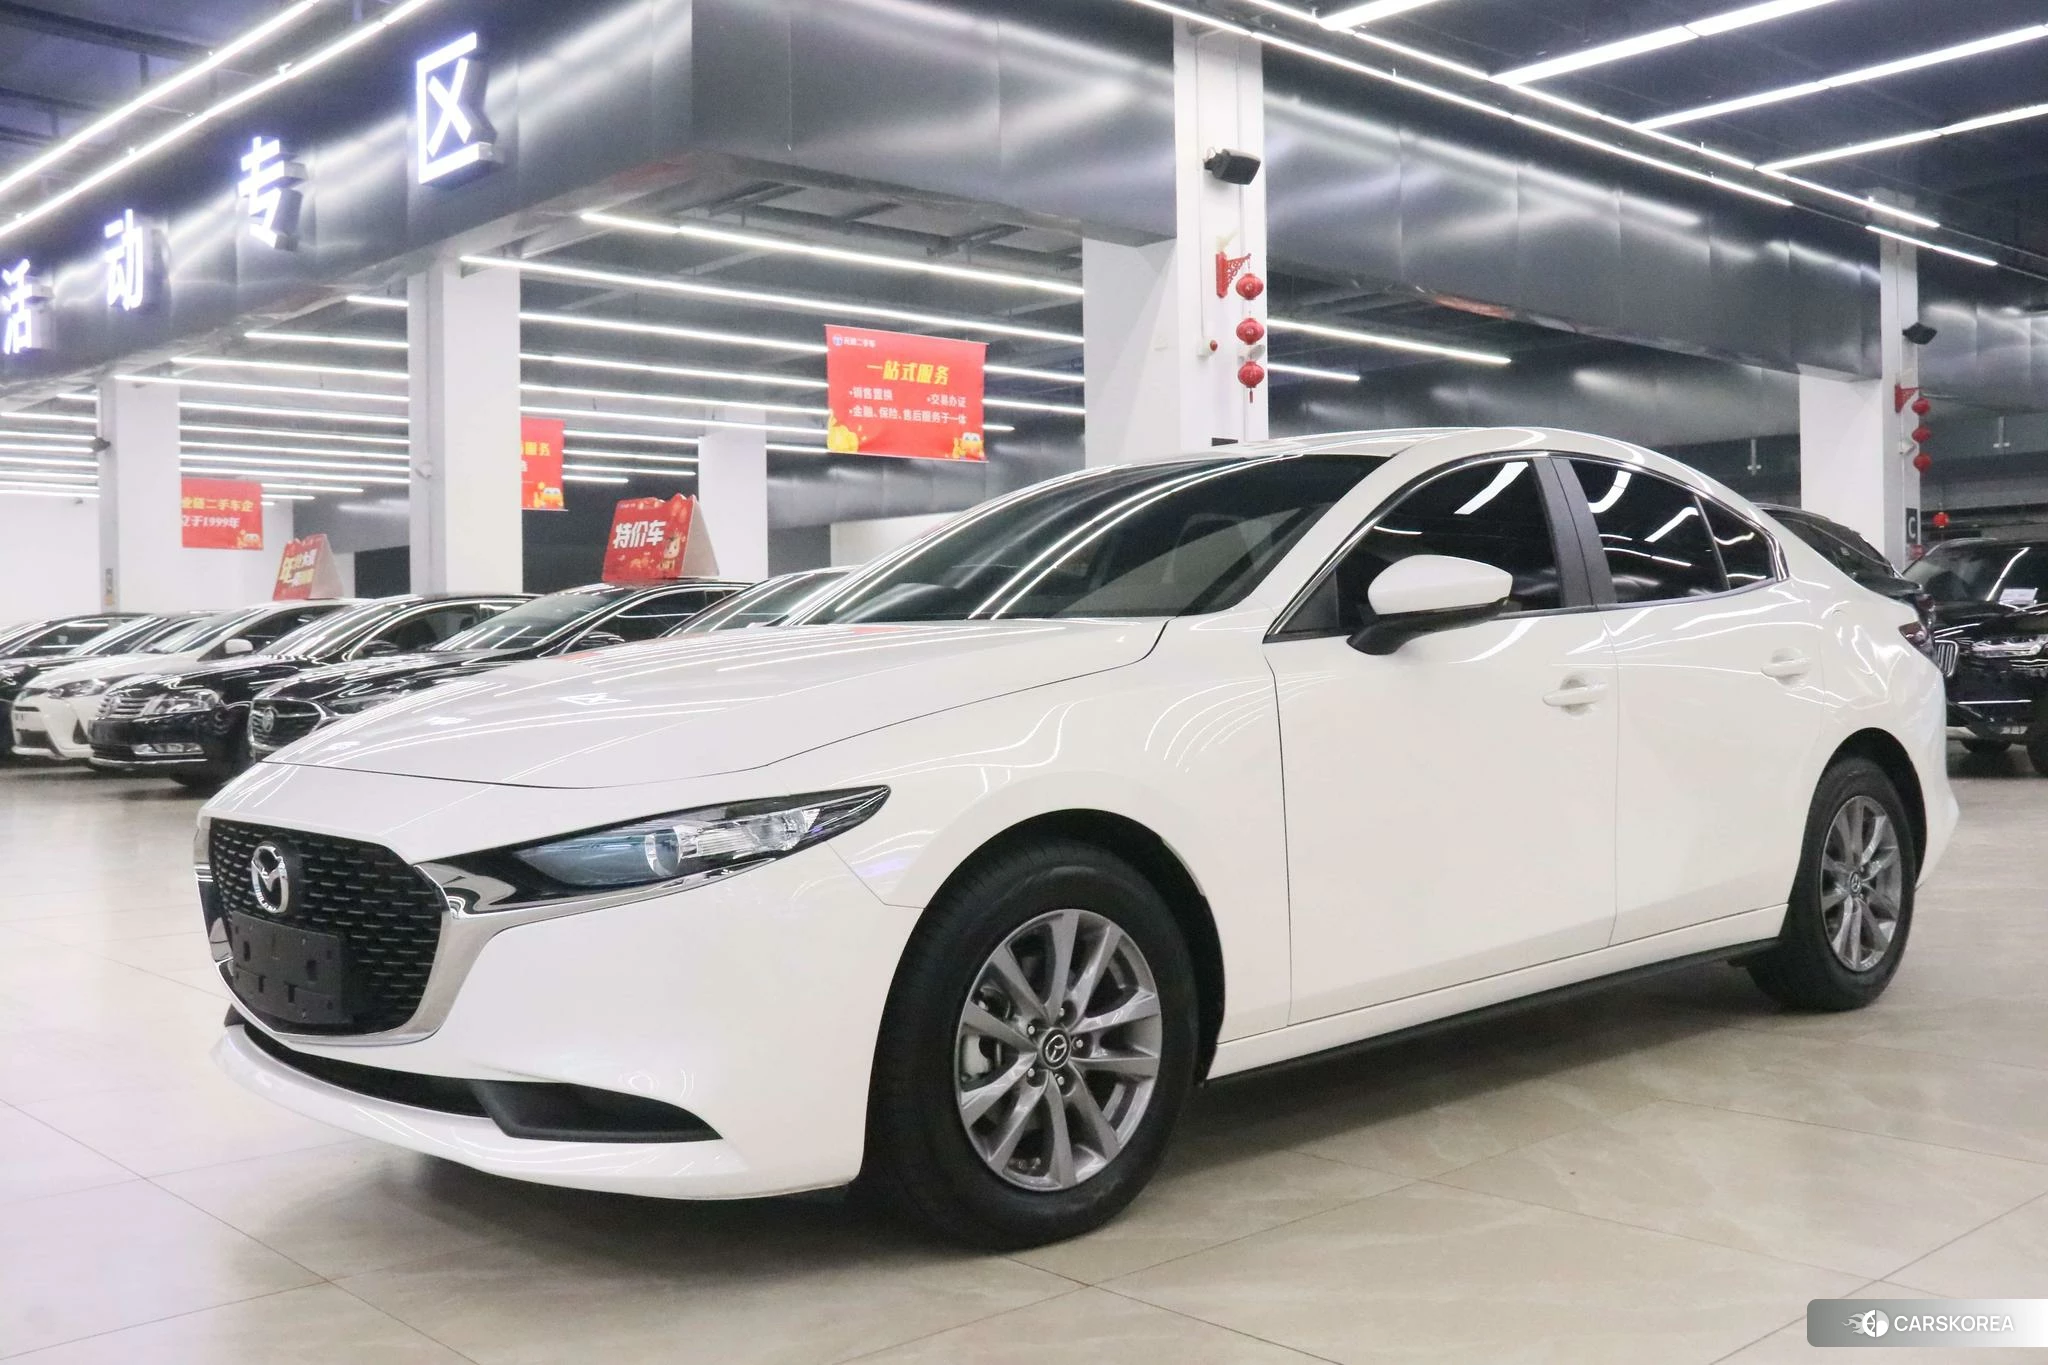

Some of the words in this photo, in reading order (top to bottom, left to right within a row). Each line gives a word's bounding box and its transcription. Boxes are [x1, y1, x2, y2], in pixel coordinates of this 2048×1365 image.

[2, 32, 478, 355] 活动专区
[866, 360, 949, 385] 一站式服务
[930, 393, 967, 408] 交易办证
[520, 441, 551, 456] 服务
[613, 520, 667, 549] 特价车
[1908, 516, 1916, 539] C
